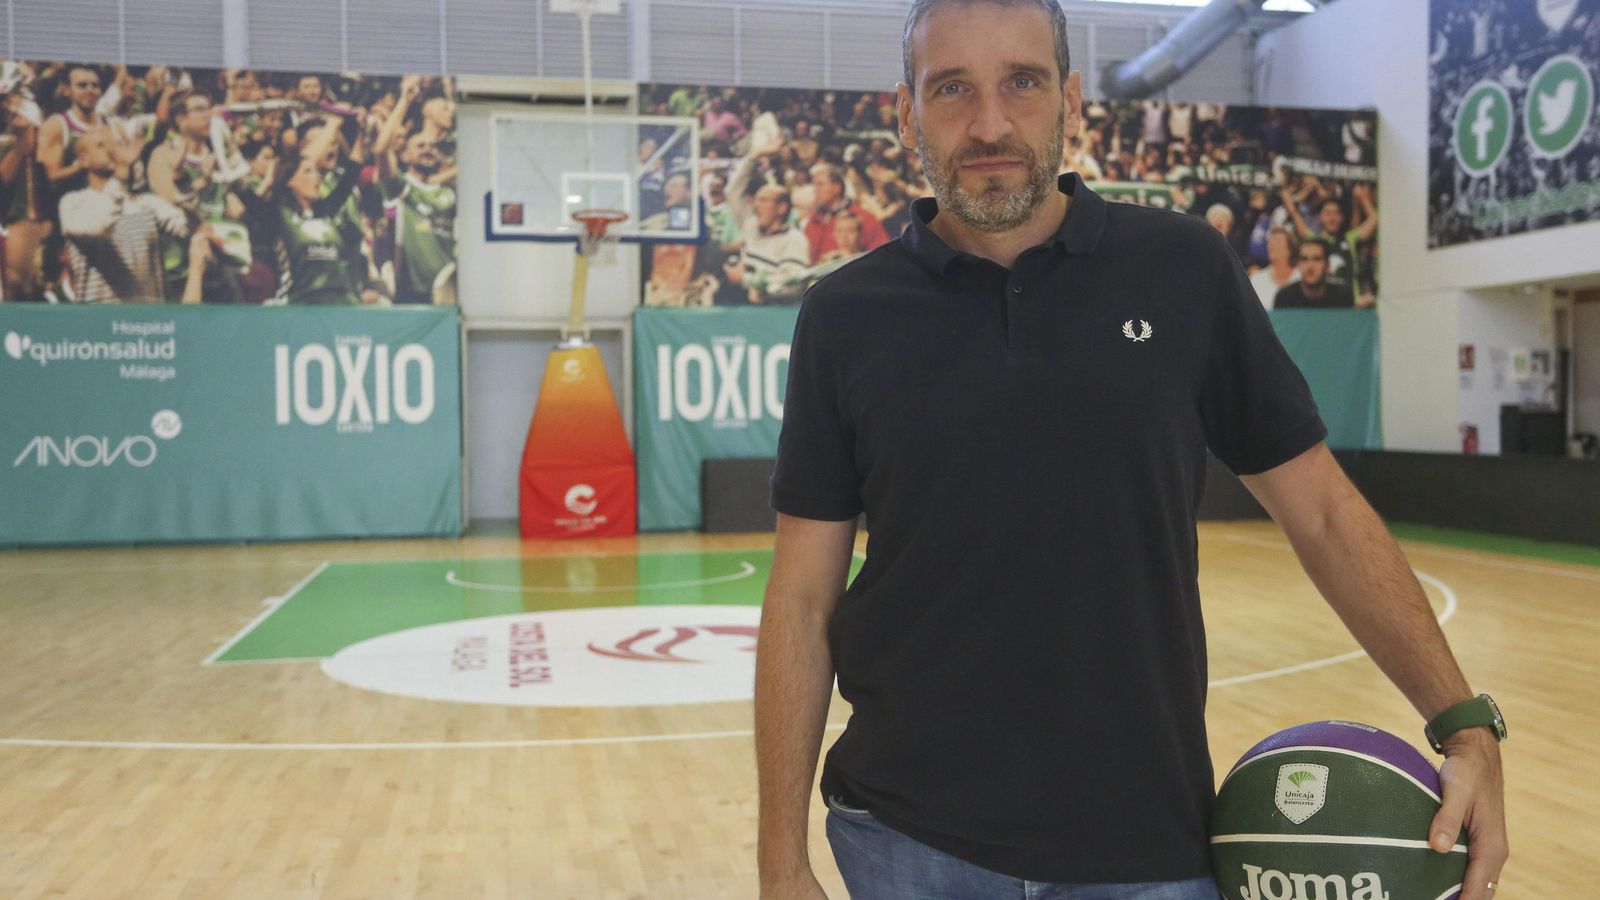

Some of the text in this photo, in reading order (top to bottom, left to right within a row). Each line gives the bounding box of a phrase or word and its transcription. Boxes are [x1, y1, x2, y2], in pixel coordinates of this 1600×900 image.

[112, 320, 176, 336] Hospital
[30, 337, 177, 366] quirónsalud
[13, 434, 158, 468] ANOVO
[1285, 790, 1314, 800] Unicaja
[1240, 863, 1390, 900] Joma
